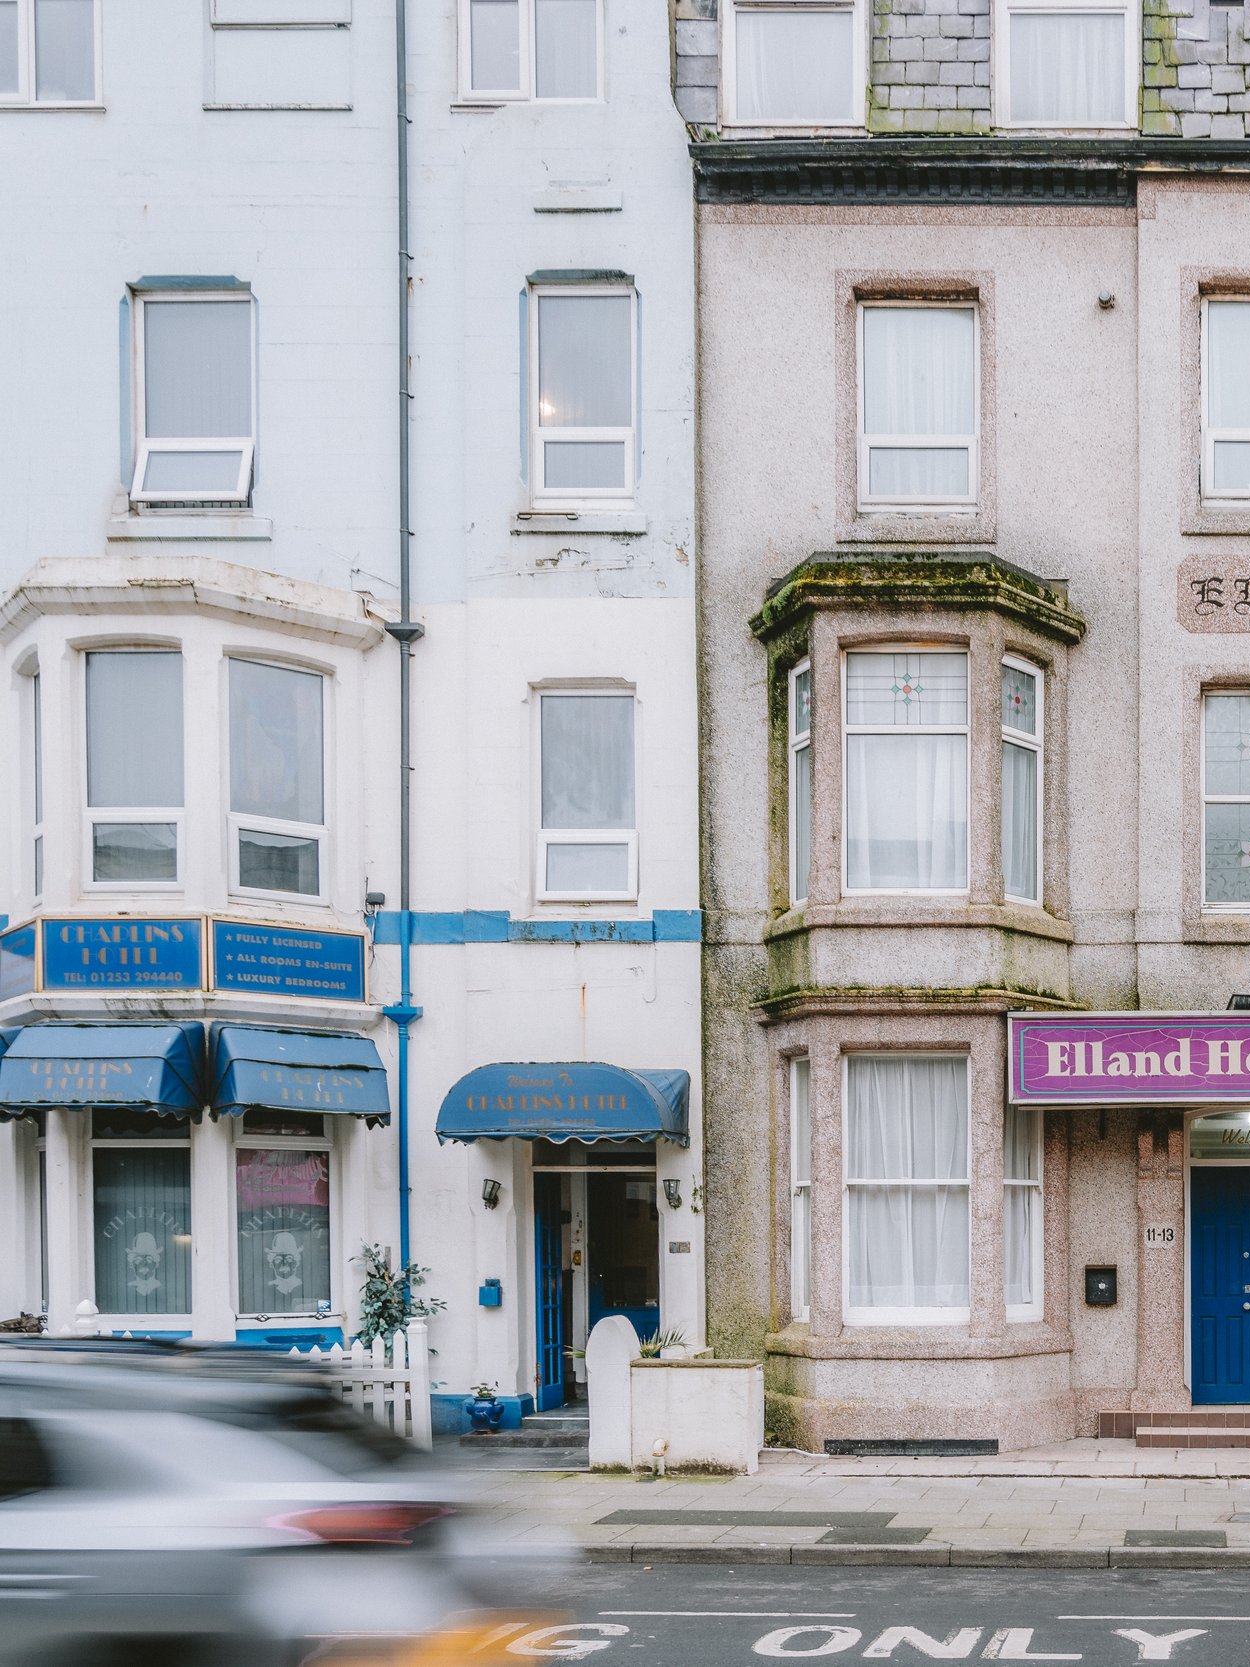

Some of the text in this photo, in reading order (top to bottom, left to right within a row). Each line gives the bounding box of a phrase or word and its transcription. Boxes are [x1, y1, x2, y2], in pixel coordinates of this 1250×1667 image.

[60, 925, 184, 943] CHAPLINS
[236, 933, 322, 949] FULLY LICENSED
[82, 948, 162, 965] HOTEL
[236, 953, 353, 972] ALL ROOMS EN-SUITE
[63, 971, 183, 982] TEL: 01253 294440
[237, 973, 346, 990] LUXURY BEDROOMS
[1045, 1037, 1194, 1077] Elland
[1146, 1228, 1174, 1242] 11-13
[751, 1624, 1209, 1660] ONLY
